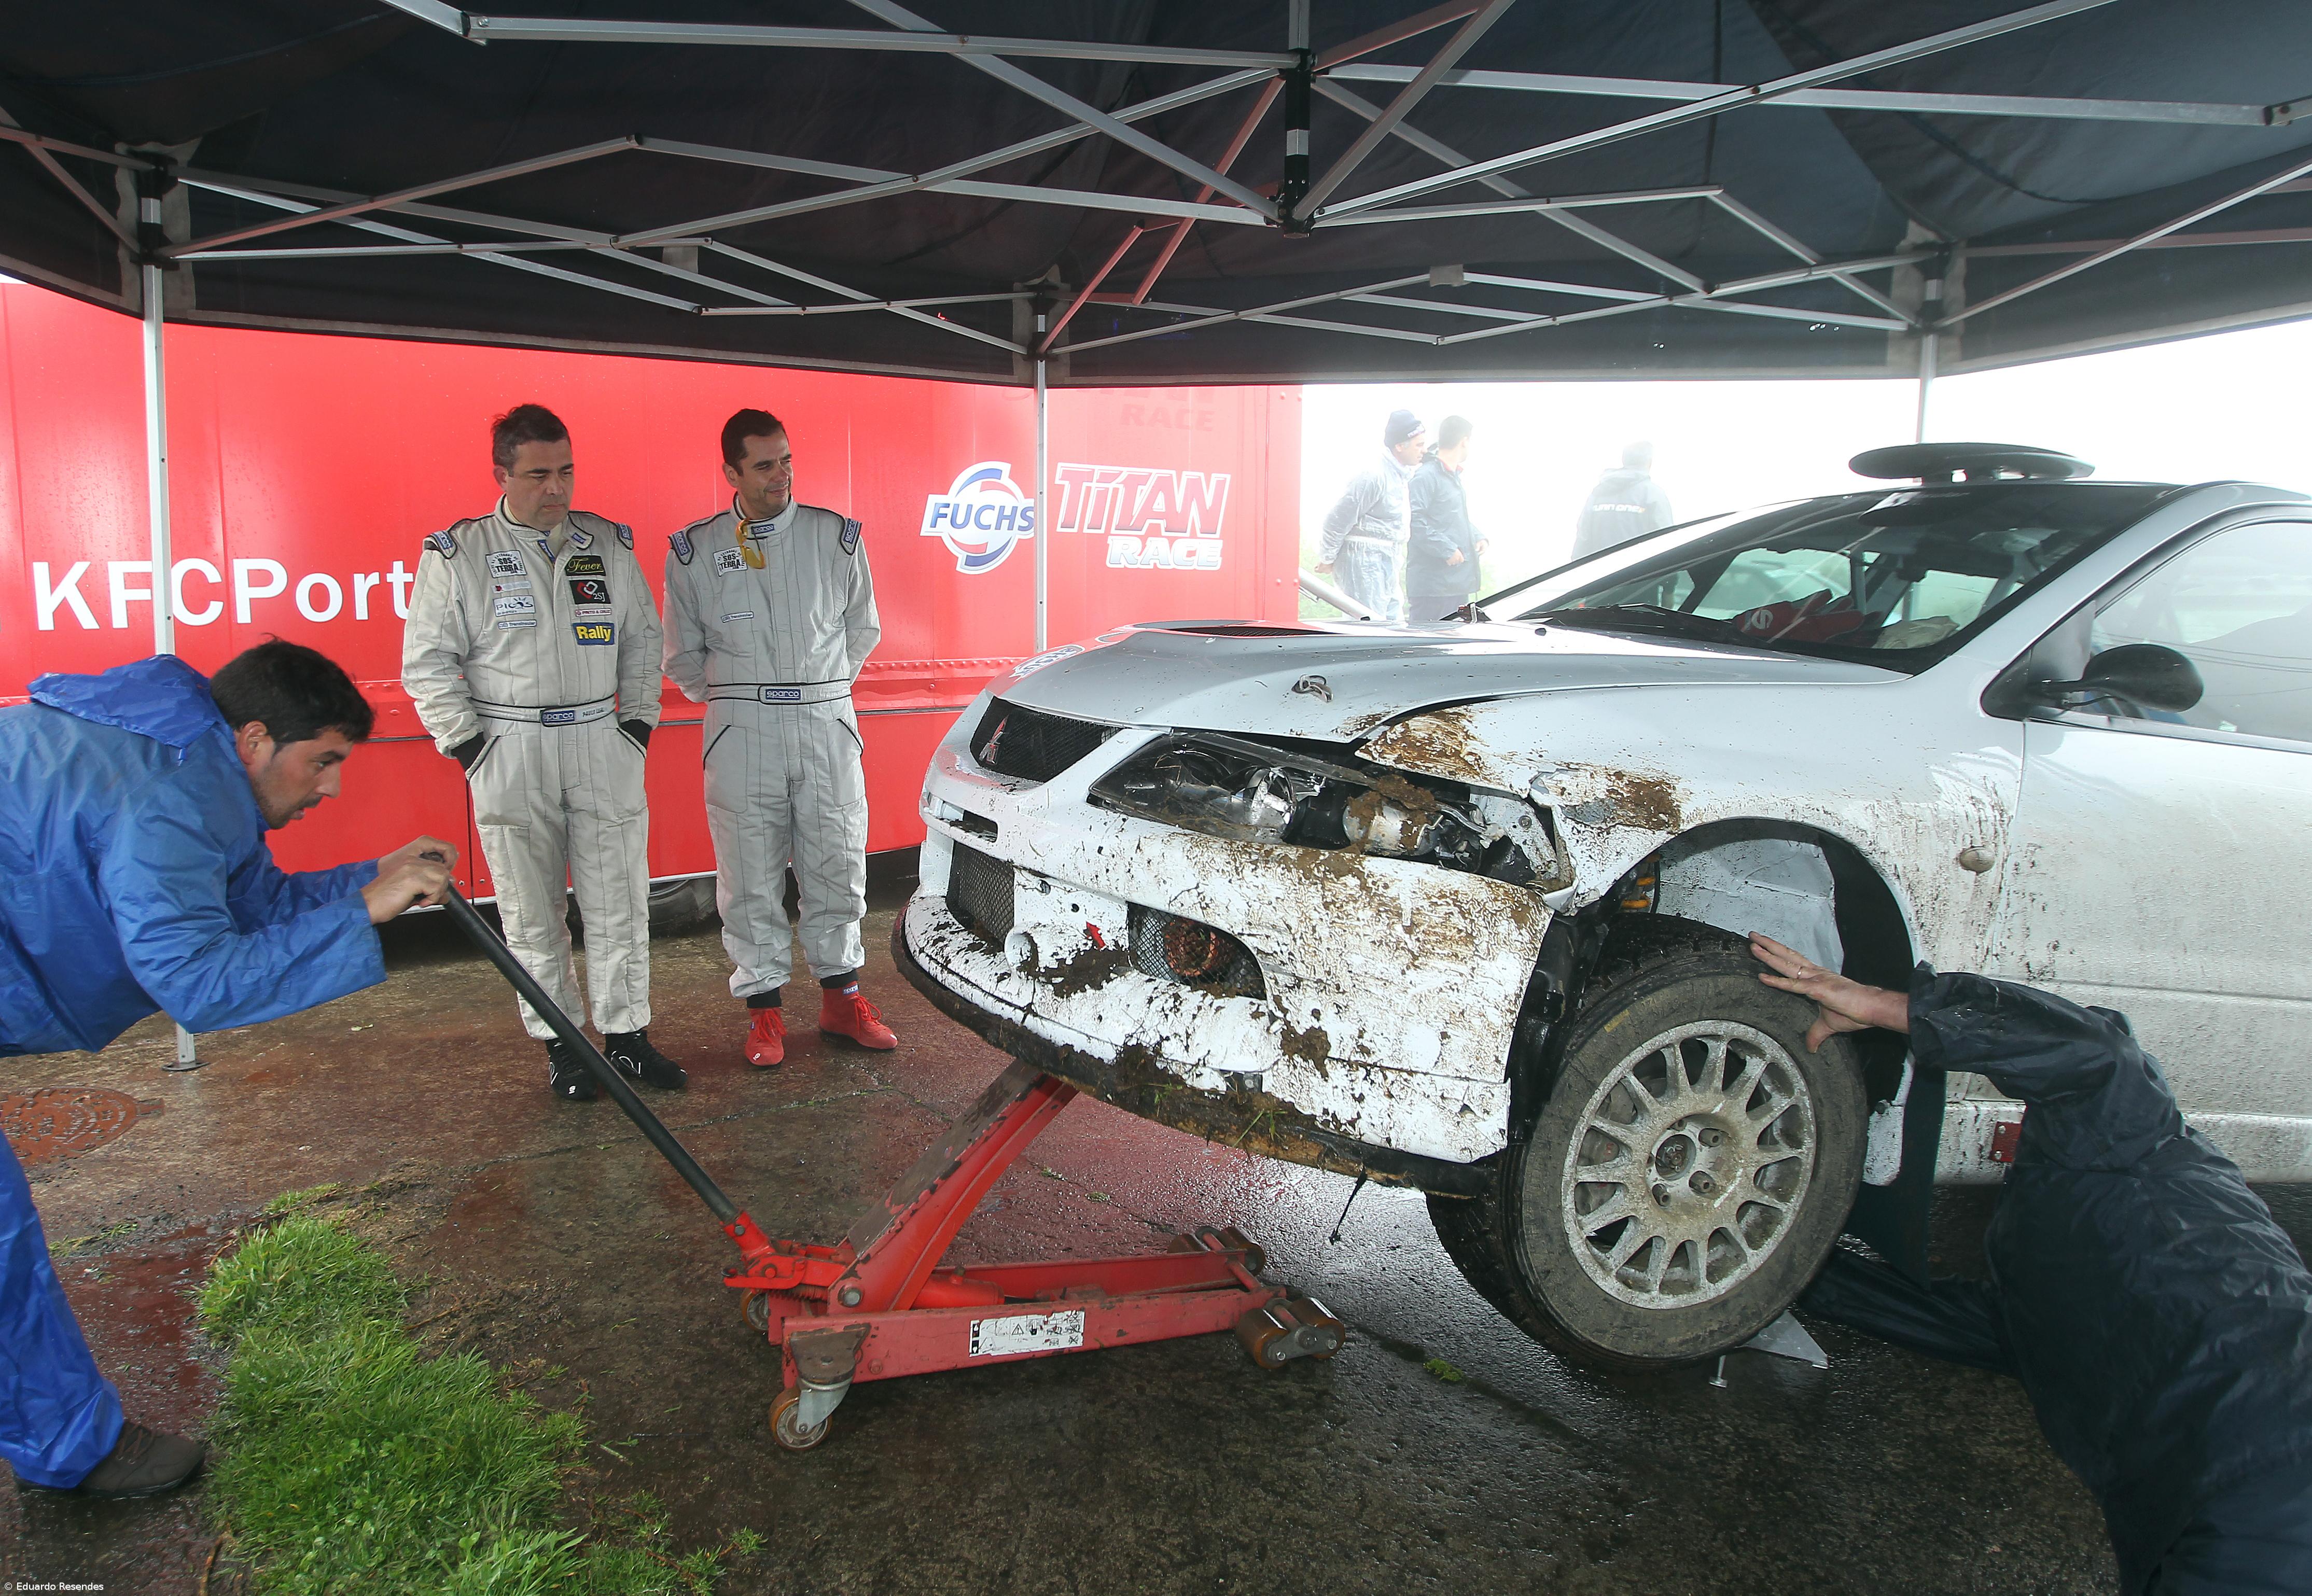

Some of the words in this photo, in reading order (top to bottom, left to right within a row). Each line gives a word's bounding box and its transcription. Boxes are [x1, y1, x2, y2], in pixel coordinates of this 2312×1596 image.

[929, 501, 1035, 533] FUCHS
[1107, 536, 1223, 570] RACE
[495, 564, 519, 572] TERRA
[567, 558, 602, 572] Fever
[719, 559, 742, 570] TERRA
[593, 592, 606, 602] 2SJ
[576, 625, 611, 642] Rally
